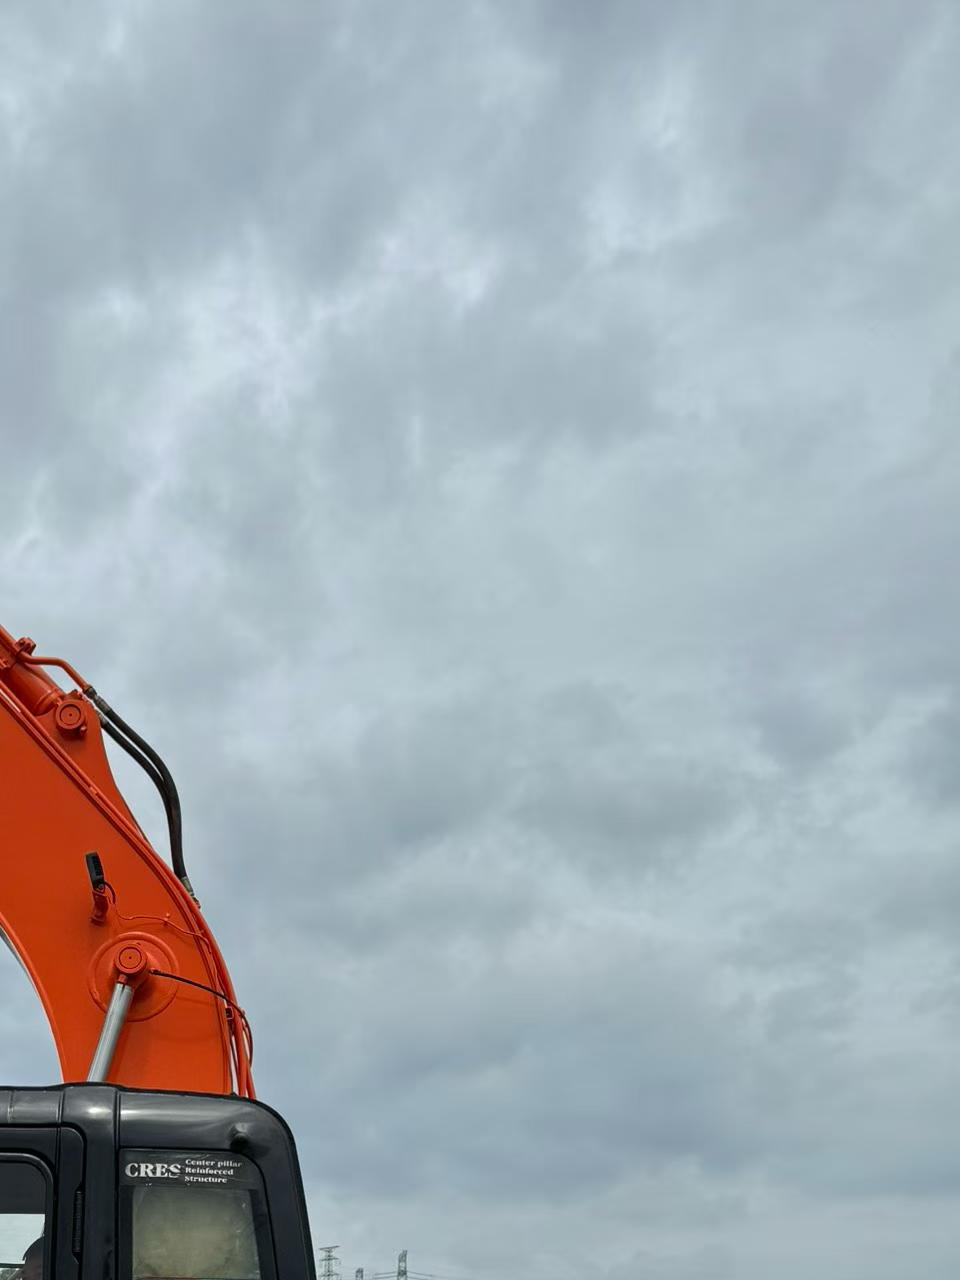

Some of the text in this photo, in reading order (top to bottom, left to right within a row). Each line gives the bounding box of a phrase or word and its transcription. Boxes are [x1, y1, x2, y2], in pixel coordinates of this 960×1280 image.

[185, 1159, 215, 1167] Center
[125, 1163, 181, 1178] CRES
[185, 1167, 234, 1176] Reinforced
[184, 1176, 228, 1184] Structure
